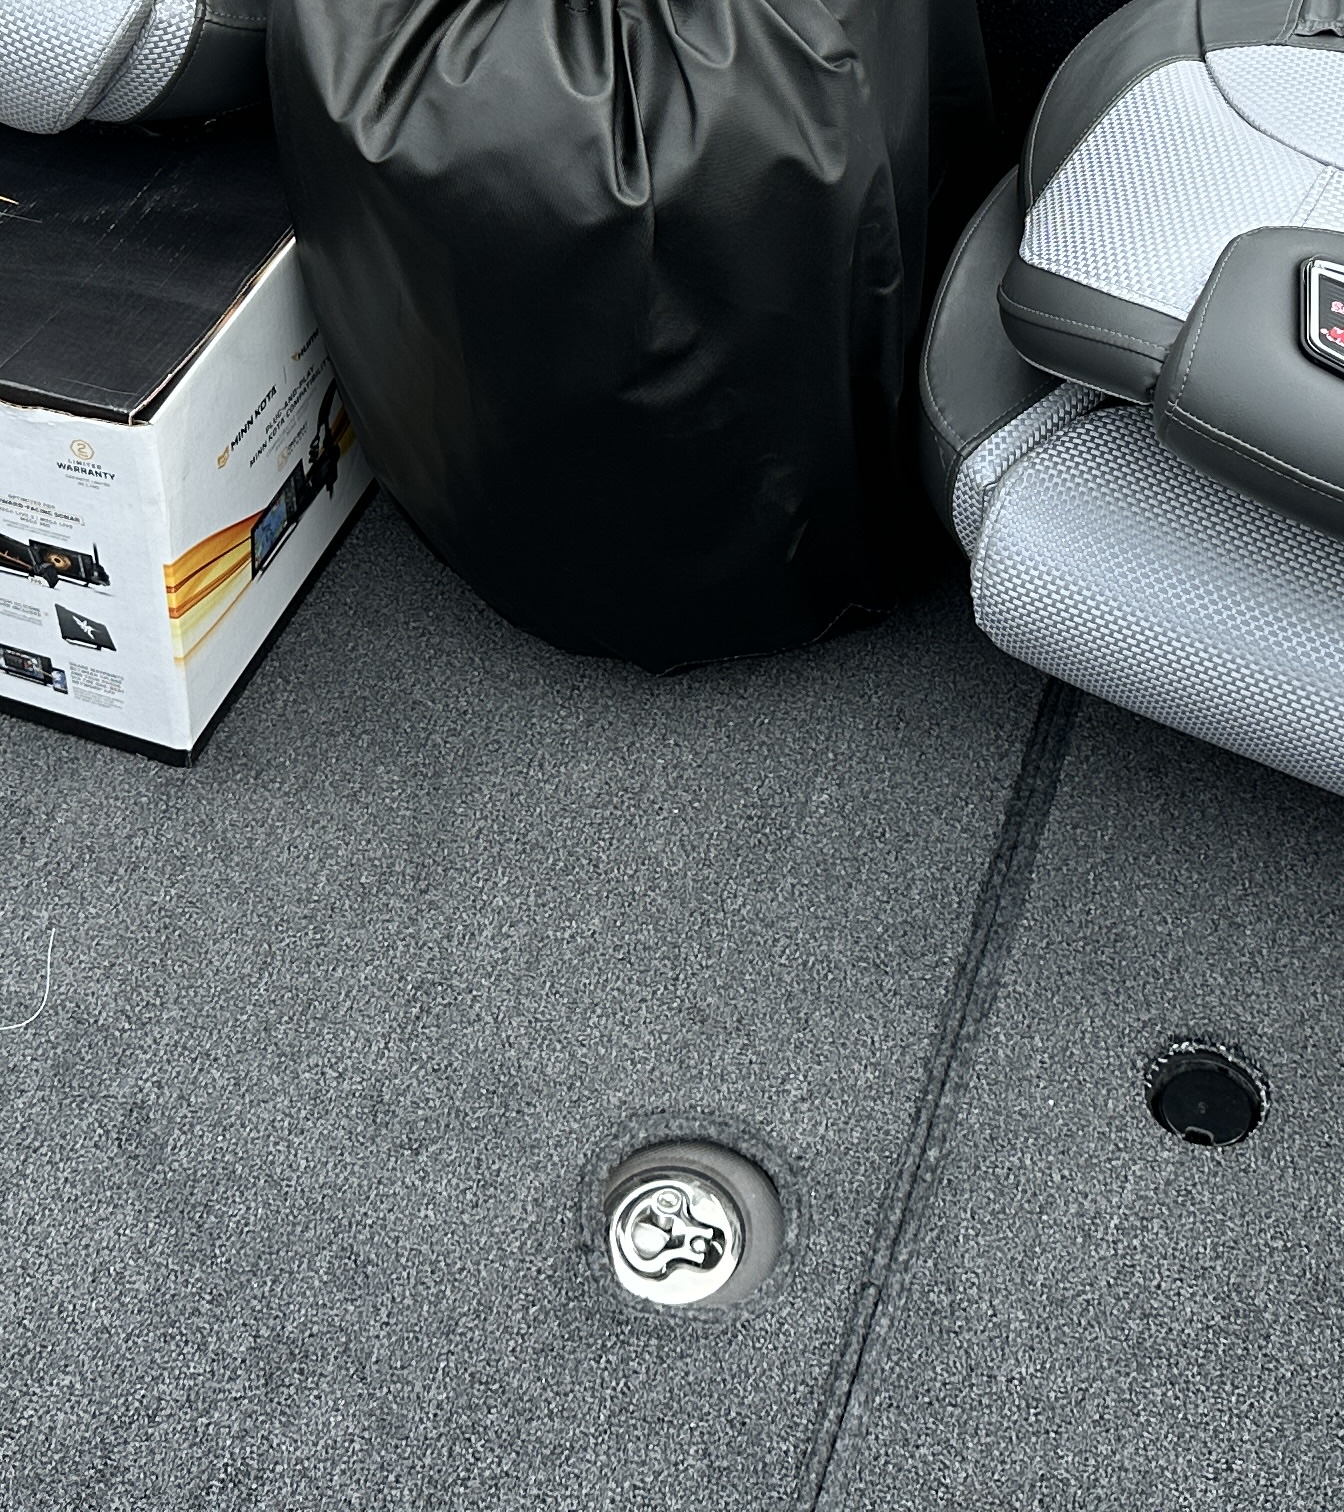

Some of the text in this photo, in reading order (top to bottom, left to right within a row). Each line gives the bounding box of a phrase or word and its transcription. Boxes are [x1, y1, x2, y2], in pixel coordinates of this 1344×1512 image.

[230, 382, 277, 452] MINN KOTA
[56, 461, 116, 481] WARRANTY
